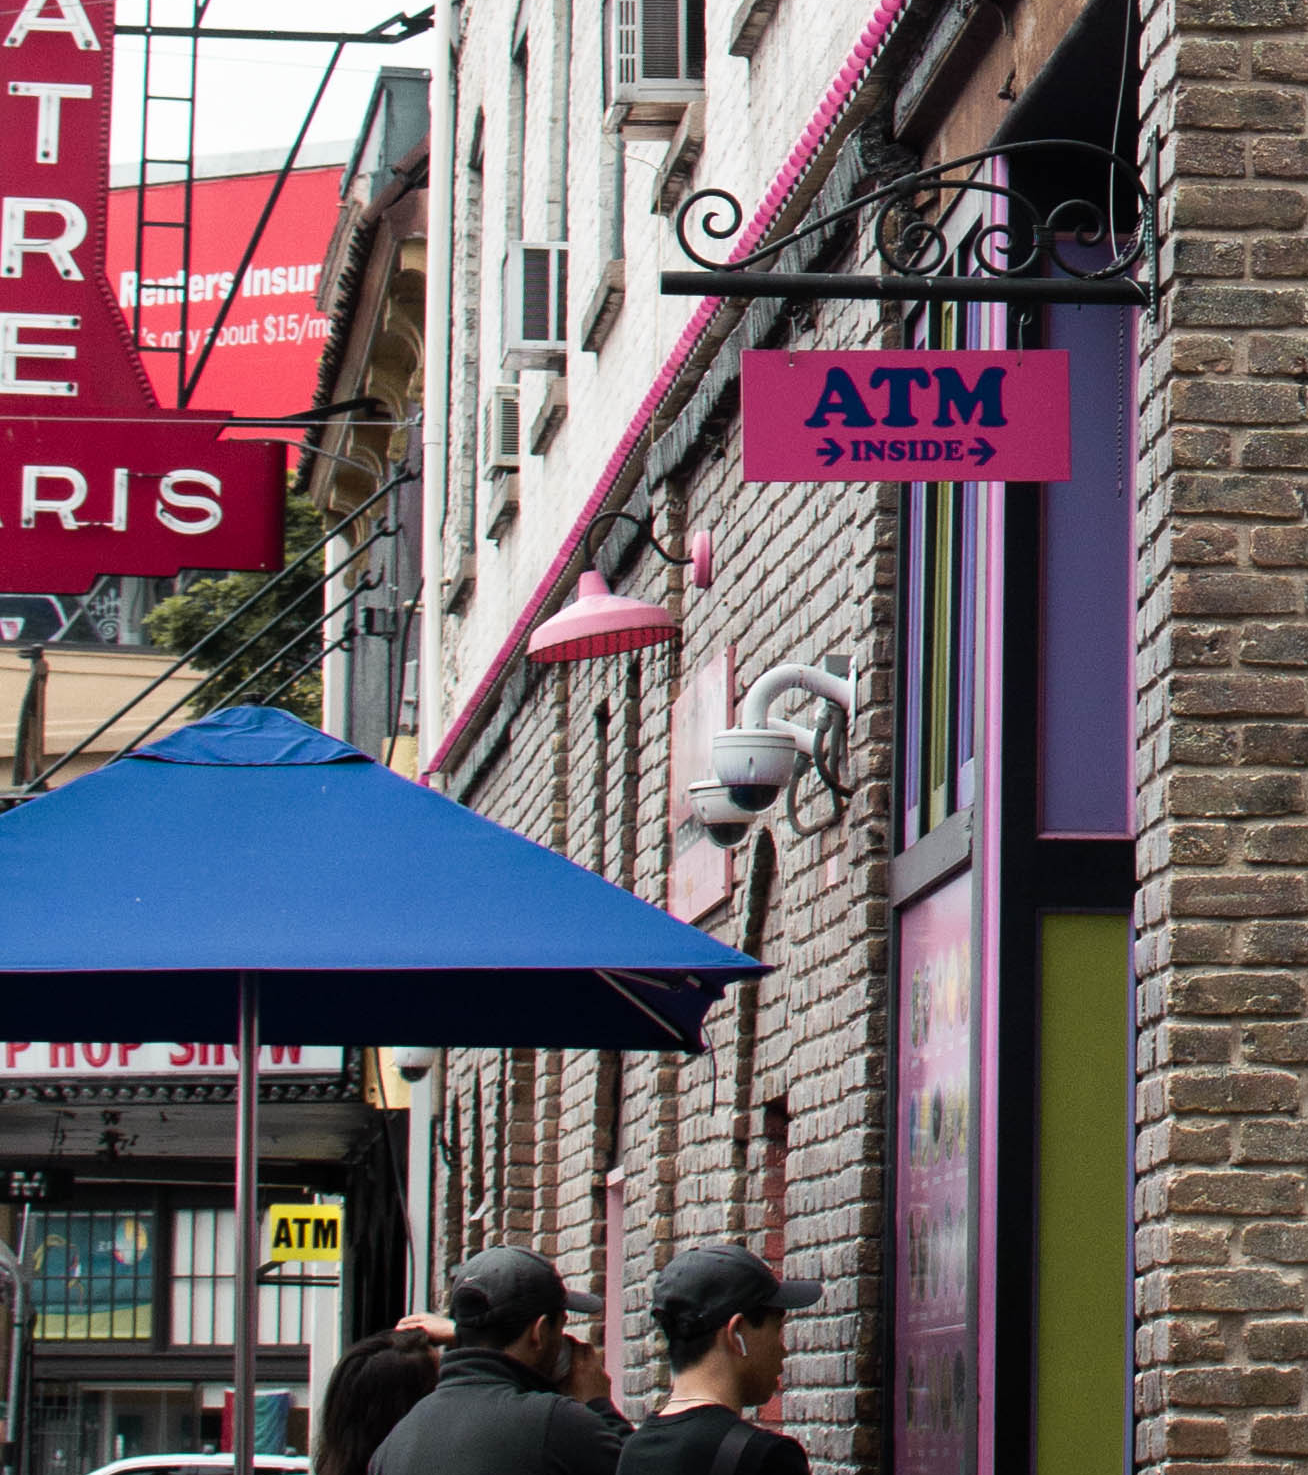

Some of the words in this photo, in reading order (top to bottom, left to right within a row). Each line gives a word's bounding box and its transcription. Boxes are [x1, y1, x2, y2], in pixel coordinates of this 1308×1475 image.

[119, 269, 236, 309] Renters
[241, 263, 321, 298] Insur
[805, 366, 1007, 428] ATM
[850, 439, 964, 462] INSIDE
[0, 464, 223, 535] RIS
[272, 1217, 339, 1250] ATM
